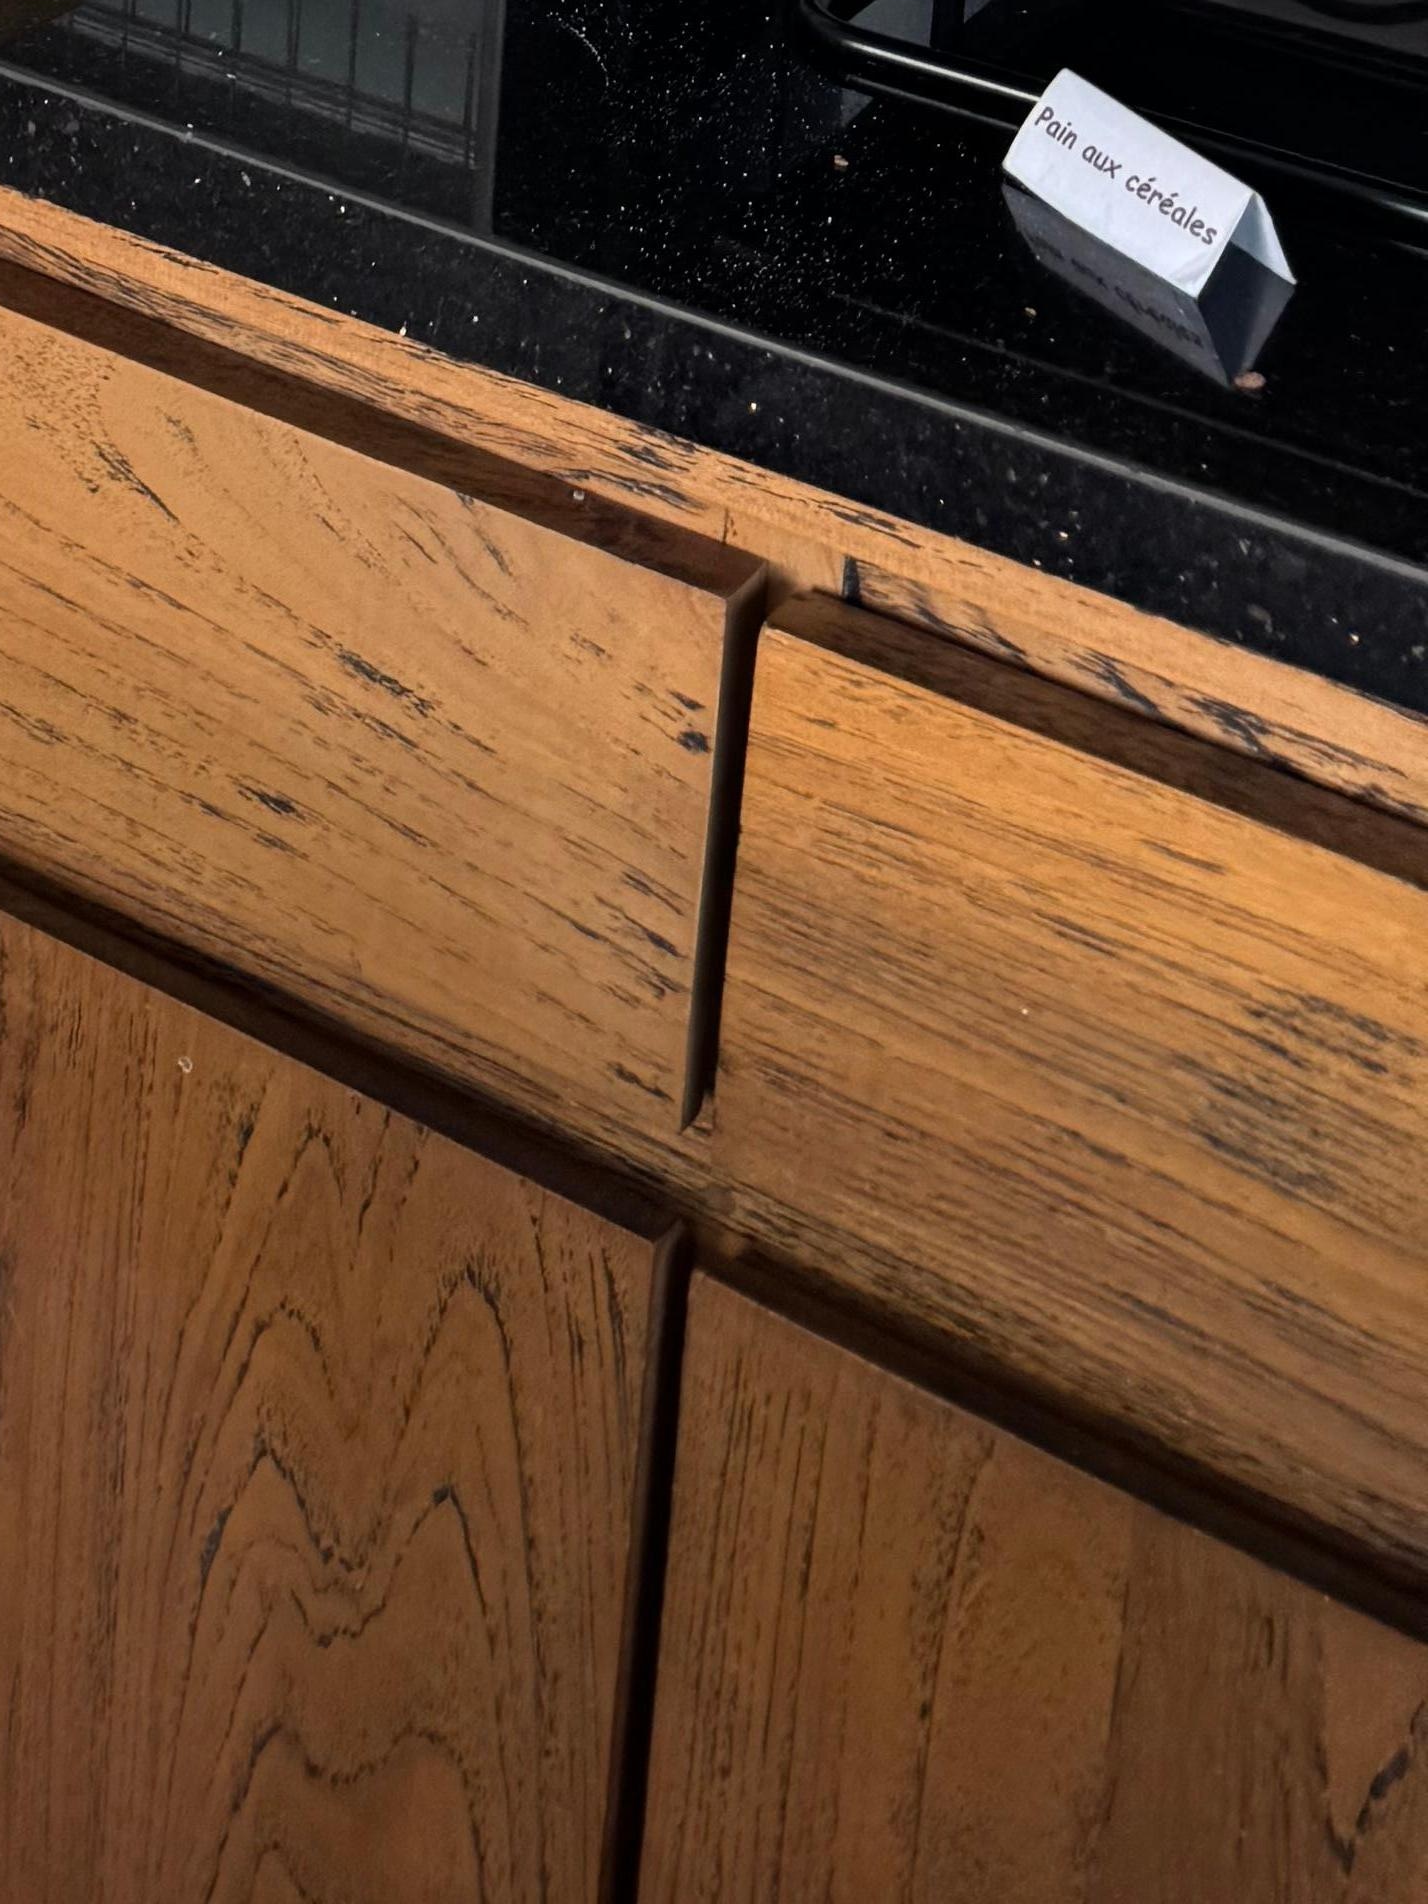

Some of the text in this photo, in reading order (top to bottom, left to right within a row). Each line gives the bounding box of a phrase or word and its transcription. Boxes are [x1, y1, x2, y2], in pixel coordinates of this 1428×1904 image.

[1034, 106, 1218, 245] Pain aux céréales
